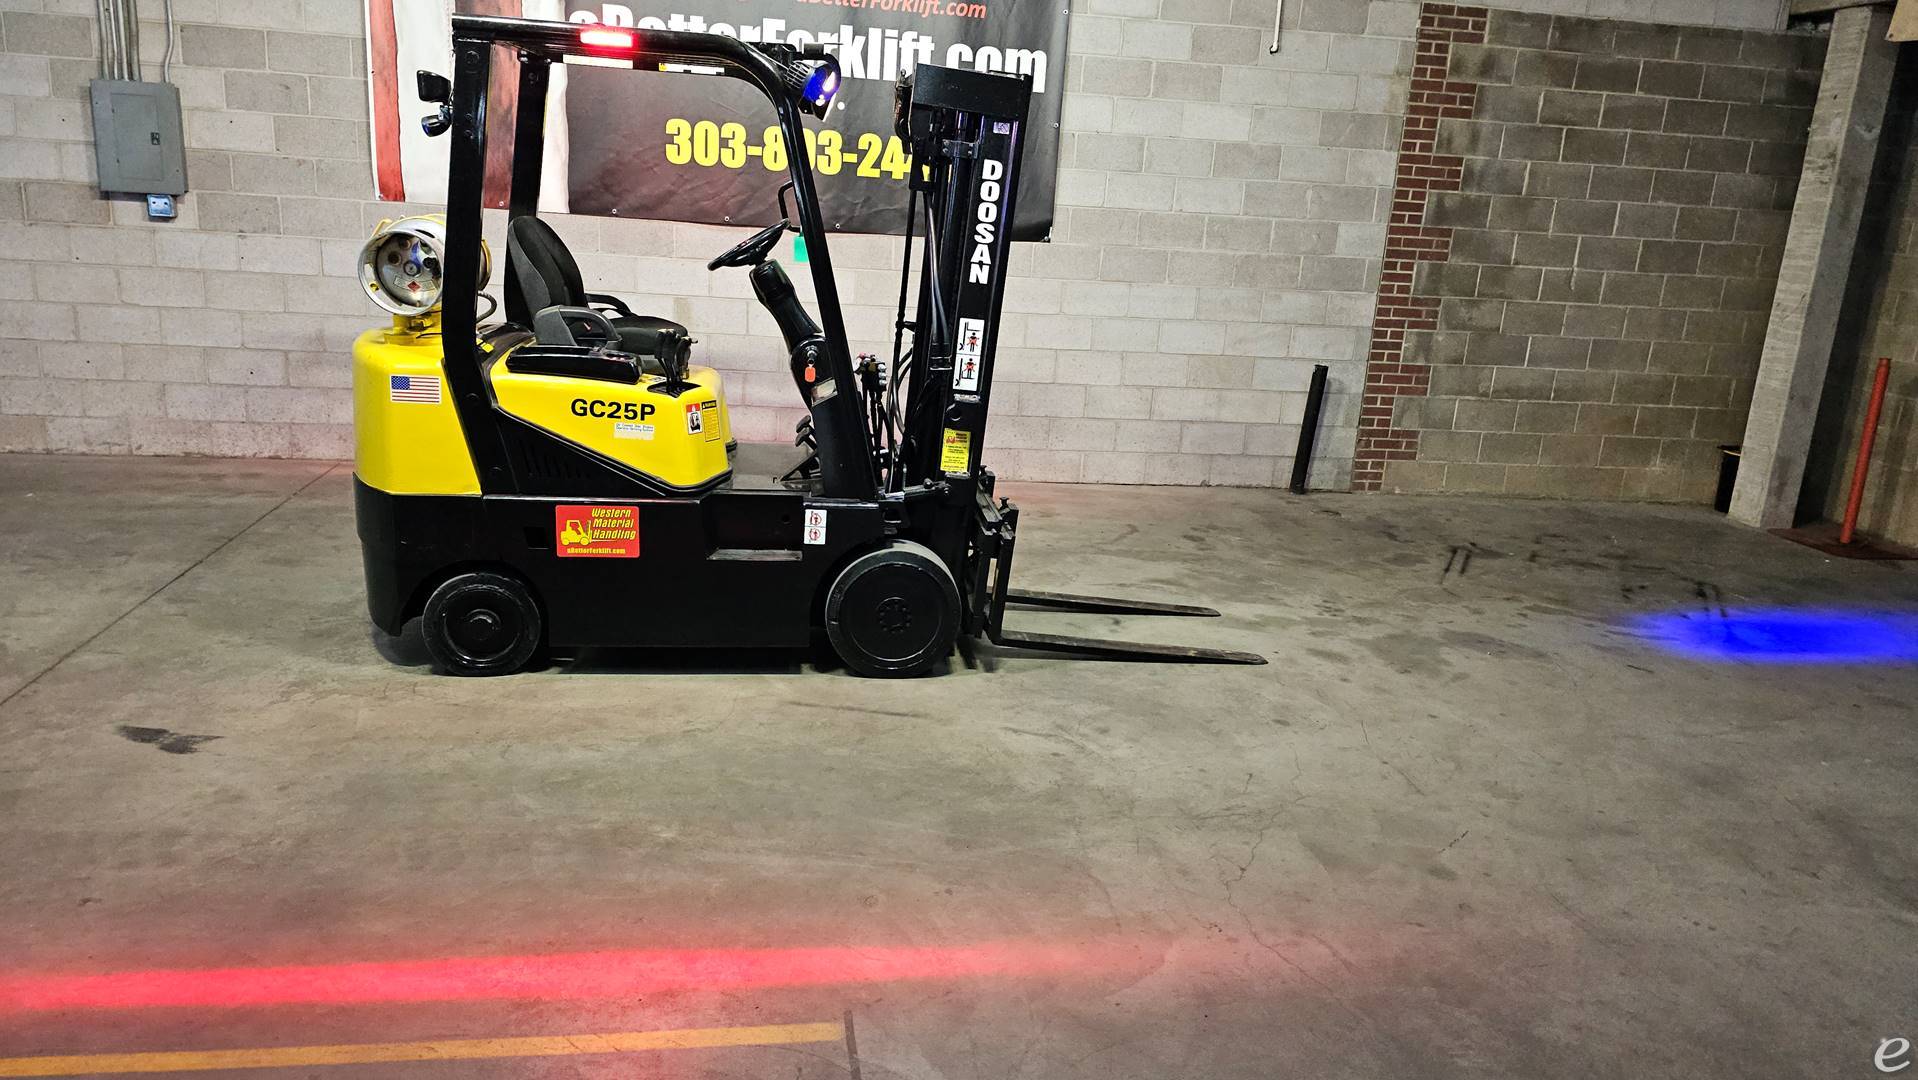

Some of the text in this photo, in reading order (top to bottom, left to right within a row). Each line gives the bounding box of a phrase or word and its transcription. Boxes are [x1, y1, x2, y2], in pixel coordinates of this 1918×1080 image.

[797, 0, 987, 18] erForklift.com
[569, 4, 1047, 93] rForkliftcom
[665, 118, 952, 181] 303-83-24
[968, 159, 1004, 285] DOOSAN
[571, 398, 656, 421] GC25P
[591, 508, 632, 518] Western
[593, 518, 635, 528] Material
[592, 529, 637, 540] Handling
